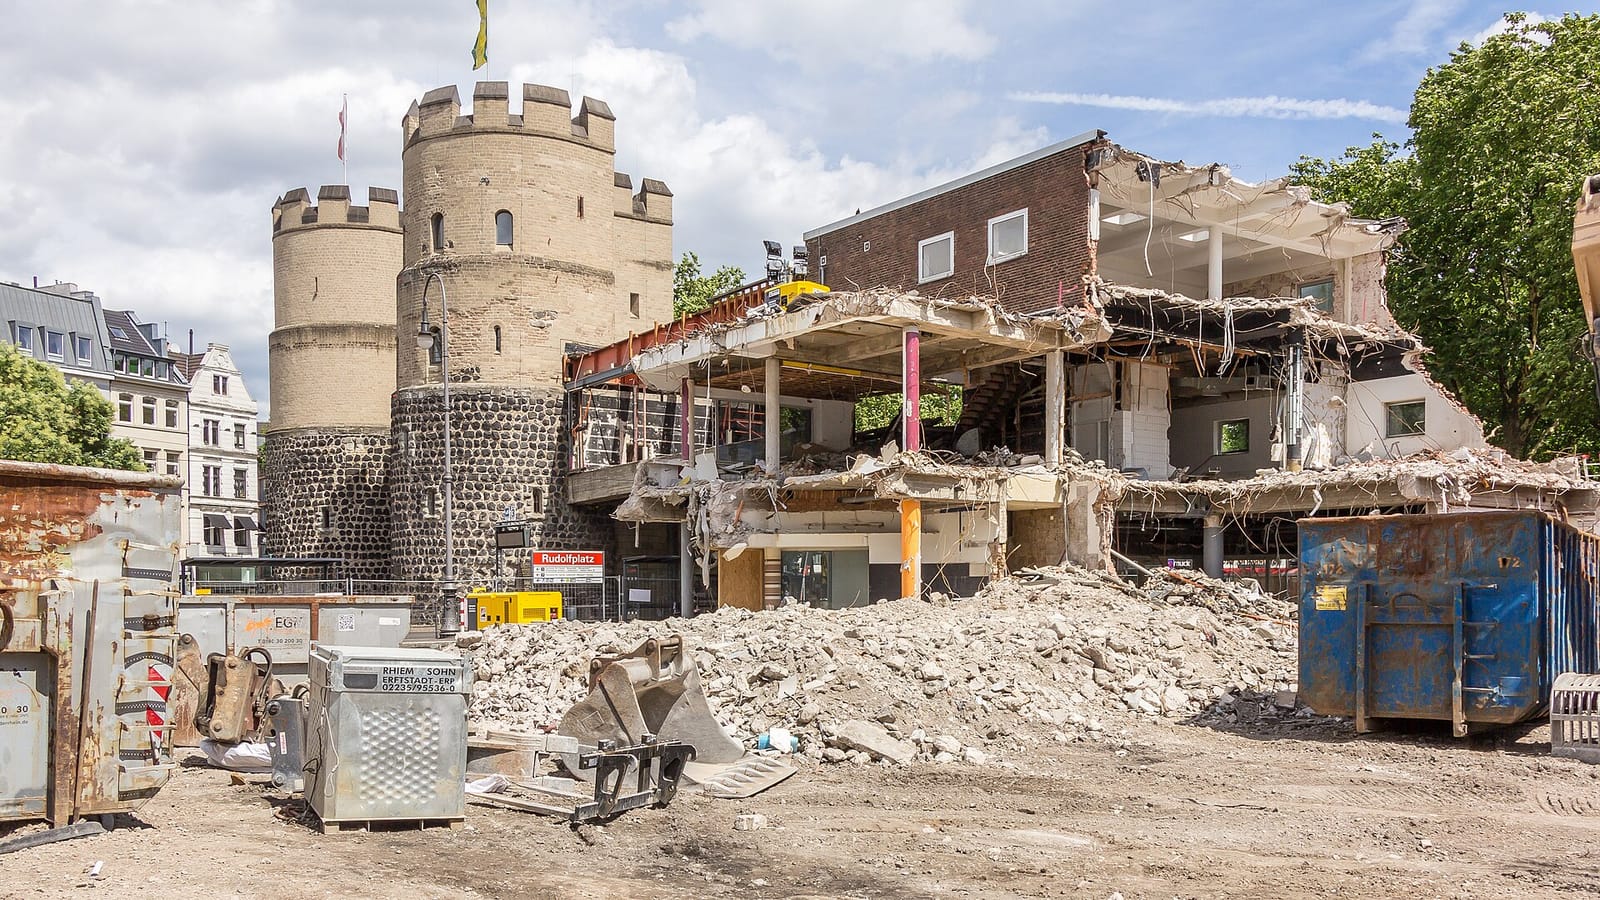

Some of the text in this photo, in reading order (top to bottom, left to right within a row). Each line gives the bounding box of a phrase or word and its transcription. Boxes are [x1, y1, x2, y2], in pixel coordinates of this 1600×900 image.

[542, 554, 594, 564] Rudolfplatz
[383, 667, 456, 676] RHIEM SOHN
[382, 684, 455, 692] 02235/95536-0
[16, 705, 28, 713] 30
